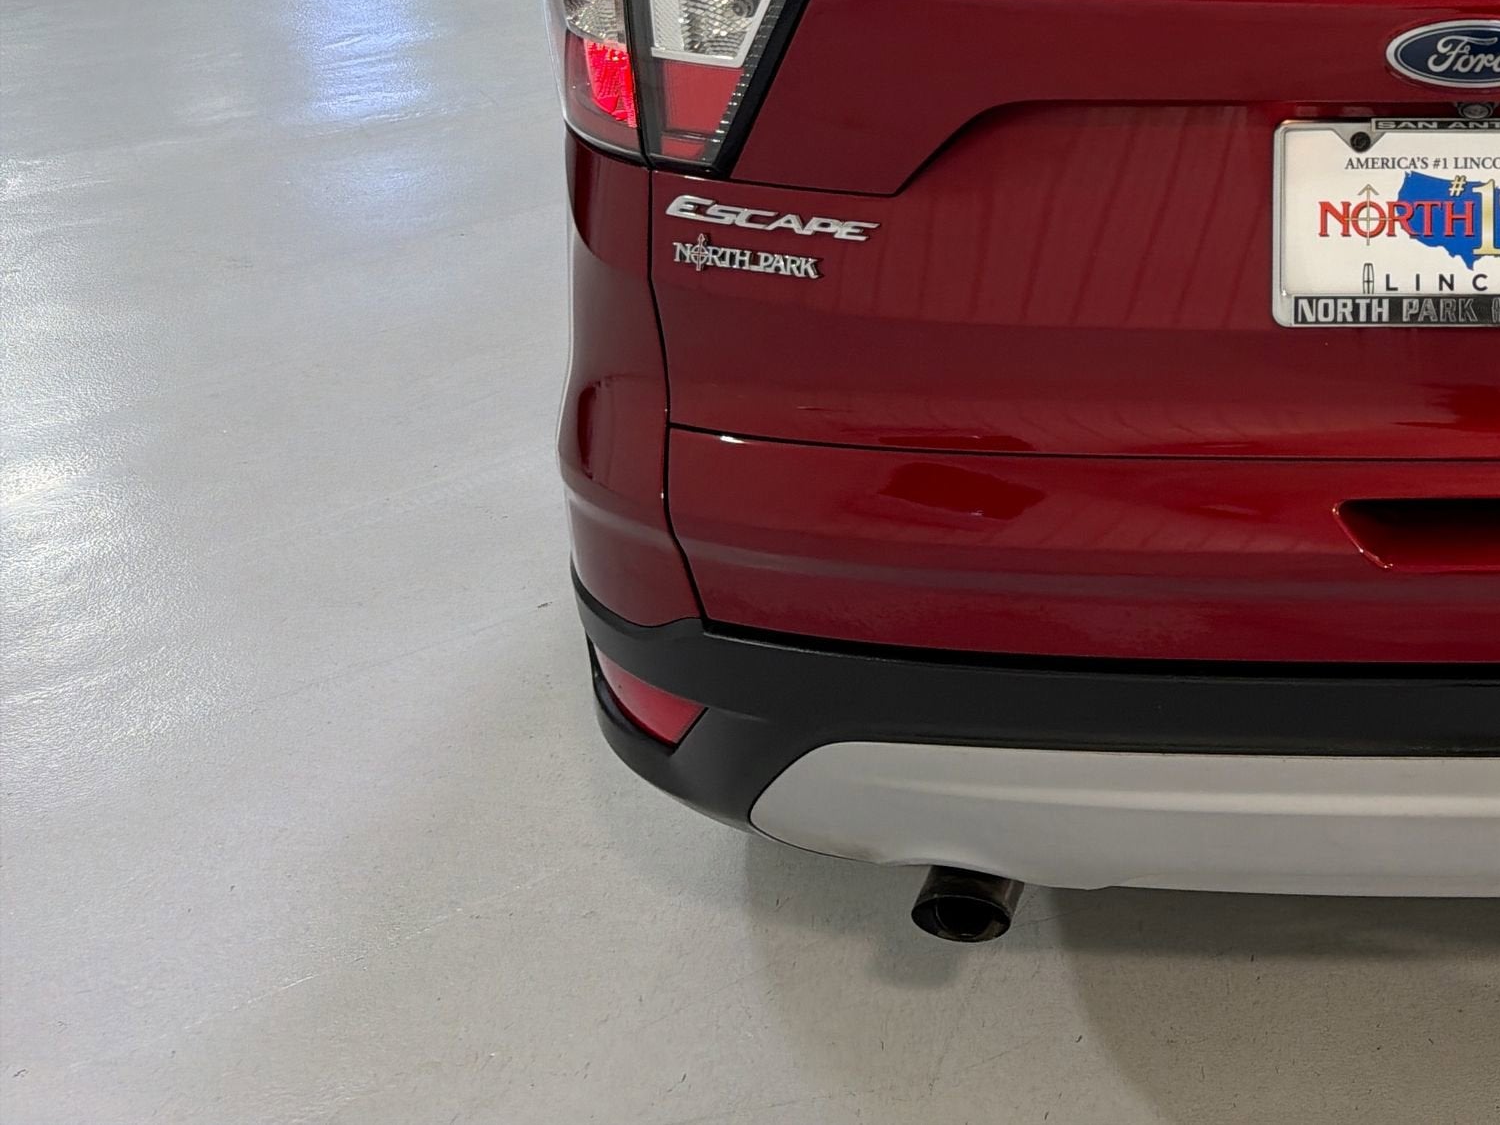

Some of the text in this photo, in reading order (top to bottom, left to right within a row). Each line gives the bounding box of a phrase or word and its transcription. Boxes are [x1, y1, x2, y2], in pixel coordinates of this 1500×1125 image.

[1377, 121, 1439, 129] SAN
[1345, 156, 1429, 170] AMERICA'S
[1433, 157, 1448, 170] #1
[665, 194, 880, 241] ESCAPE
[1318, 200, 1475, 238] NORTH
[673, 241, 820, 279] NORTH PARK
[1298, 297, 1390, 323] NORTH
[1401, 297, 1479, 323] PARK
